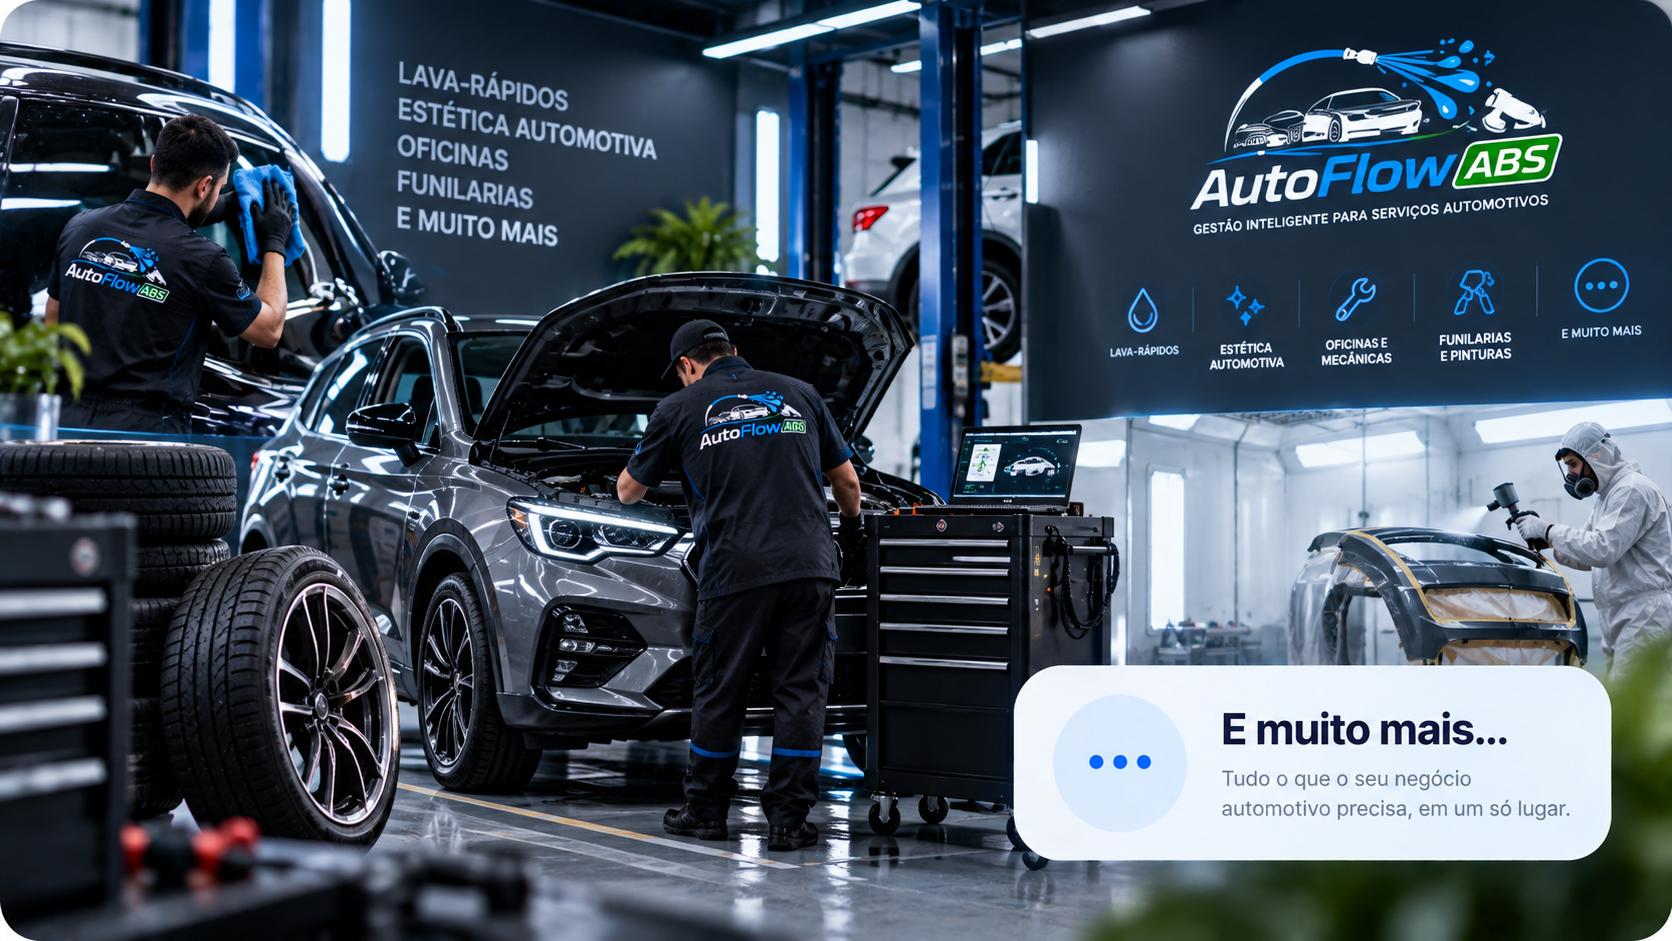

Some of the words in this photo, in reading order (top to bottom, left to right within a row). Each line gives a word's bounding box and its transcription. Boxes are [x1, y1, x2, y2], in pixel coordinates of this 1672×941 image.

[398, 61, 569, 112] LAVA-RÁPIDOS
[398, 98, 511, 137] ESTÉTICA
[515, 118, 658, 160] AUTOMOTIVA
[397, 134, 509, 171] OFICINAS
[397, 170, 533, 209] FUNILARIAS
[1190, 152, 1457, 211] AutoFlow
[1463, 144, 1550, 180] ABS
[397, 206, 411, 230] E
[418, 209, 495, 239] MUITO
[501, 219, 558, 247] MAIS
[1193, 218, 1243, 235] GESTÃO
[1246, 213, 1329, 230] INTELIGENTE
[1333, 210, 1368, 223] PARA
[1372, 204, 1440, 220] SERVIÇOS
[1443, 194, 1549, 214] AUTOMOTIVOS
[65, 263, 140, 294] AutoFlow
[140, 285, 166, 301] ABS
[1220, 341, 1272, 355] ESTÉTICA
[1325, 338, 1379, 350] OFICINAS
[1381, 338, 1388, 348] E
[1439, 331, 1512, 345] FUNILARIAS
[1562, 328, 1569, 339] E
[1571, 327, 1609, 338] MUITO
[1613, 325, 1642, 336] MAIS
[1110, 344, 1179, 358] LAVA-RÁPIDOS
[1210, 357, 1284, 370] AUTOMOTIVA
[1440, 351, 1448, 361] E
[1450, 348, 1512, 361] PINTURAS
[700, 423, 782, 450] AutoFlow
